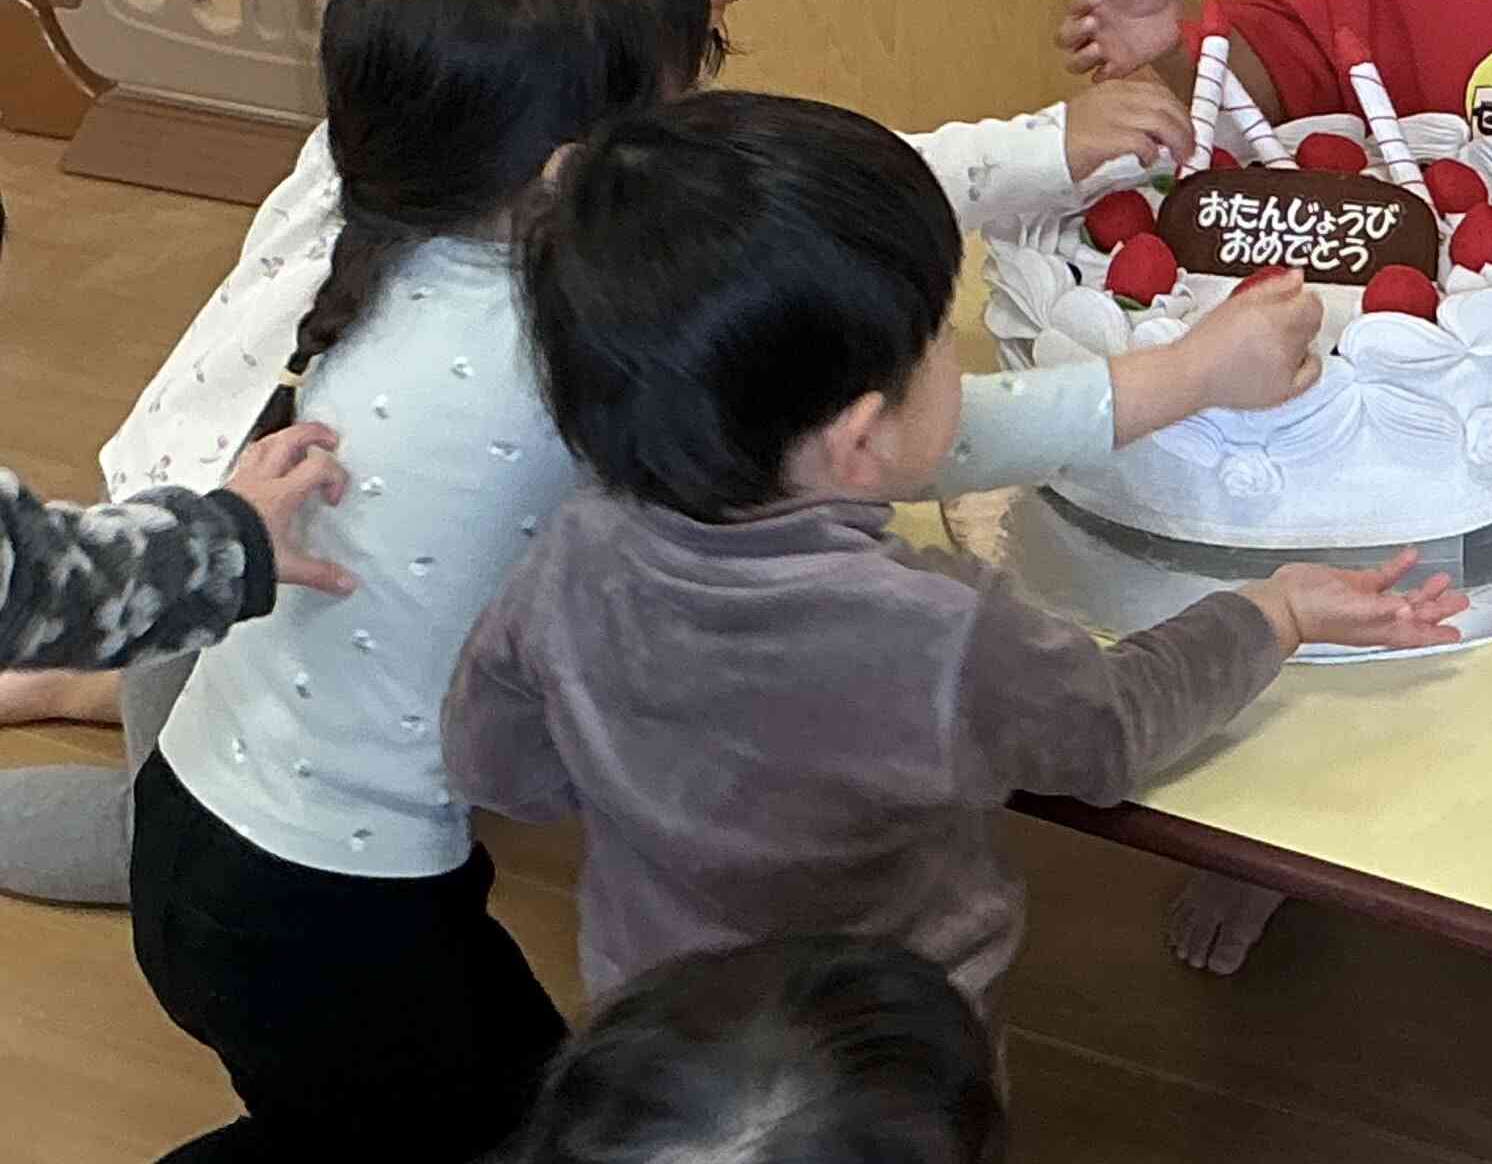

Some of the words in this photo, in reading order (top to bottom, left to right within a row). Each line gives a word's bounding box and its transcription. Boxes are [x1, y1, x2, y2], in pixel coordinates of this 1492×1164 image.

[1198, 190, 1400, 239] おたんじょうび
[1219, 231, 1370, 272] おめでとう
